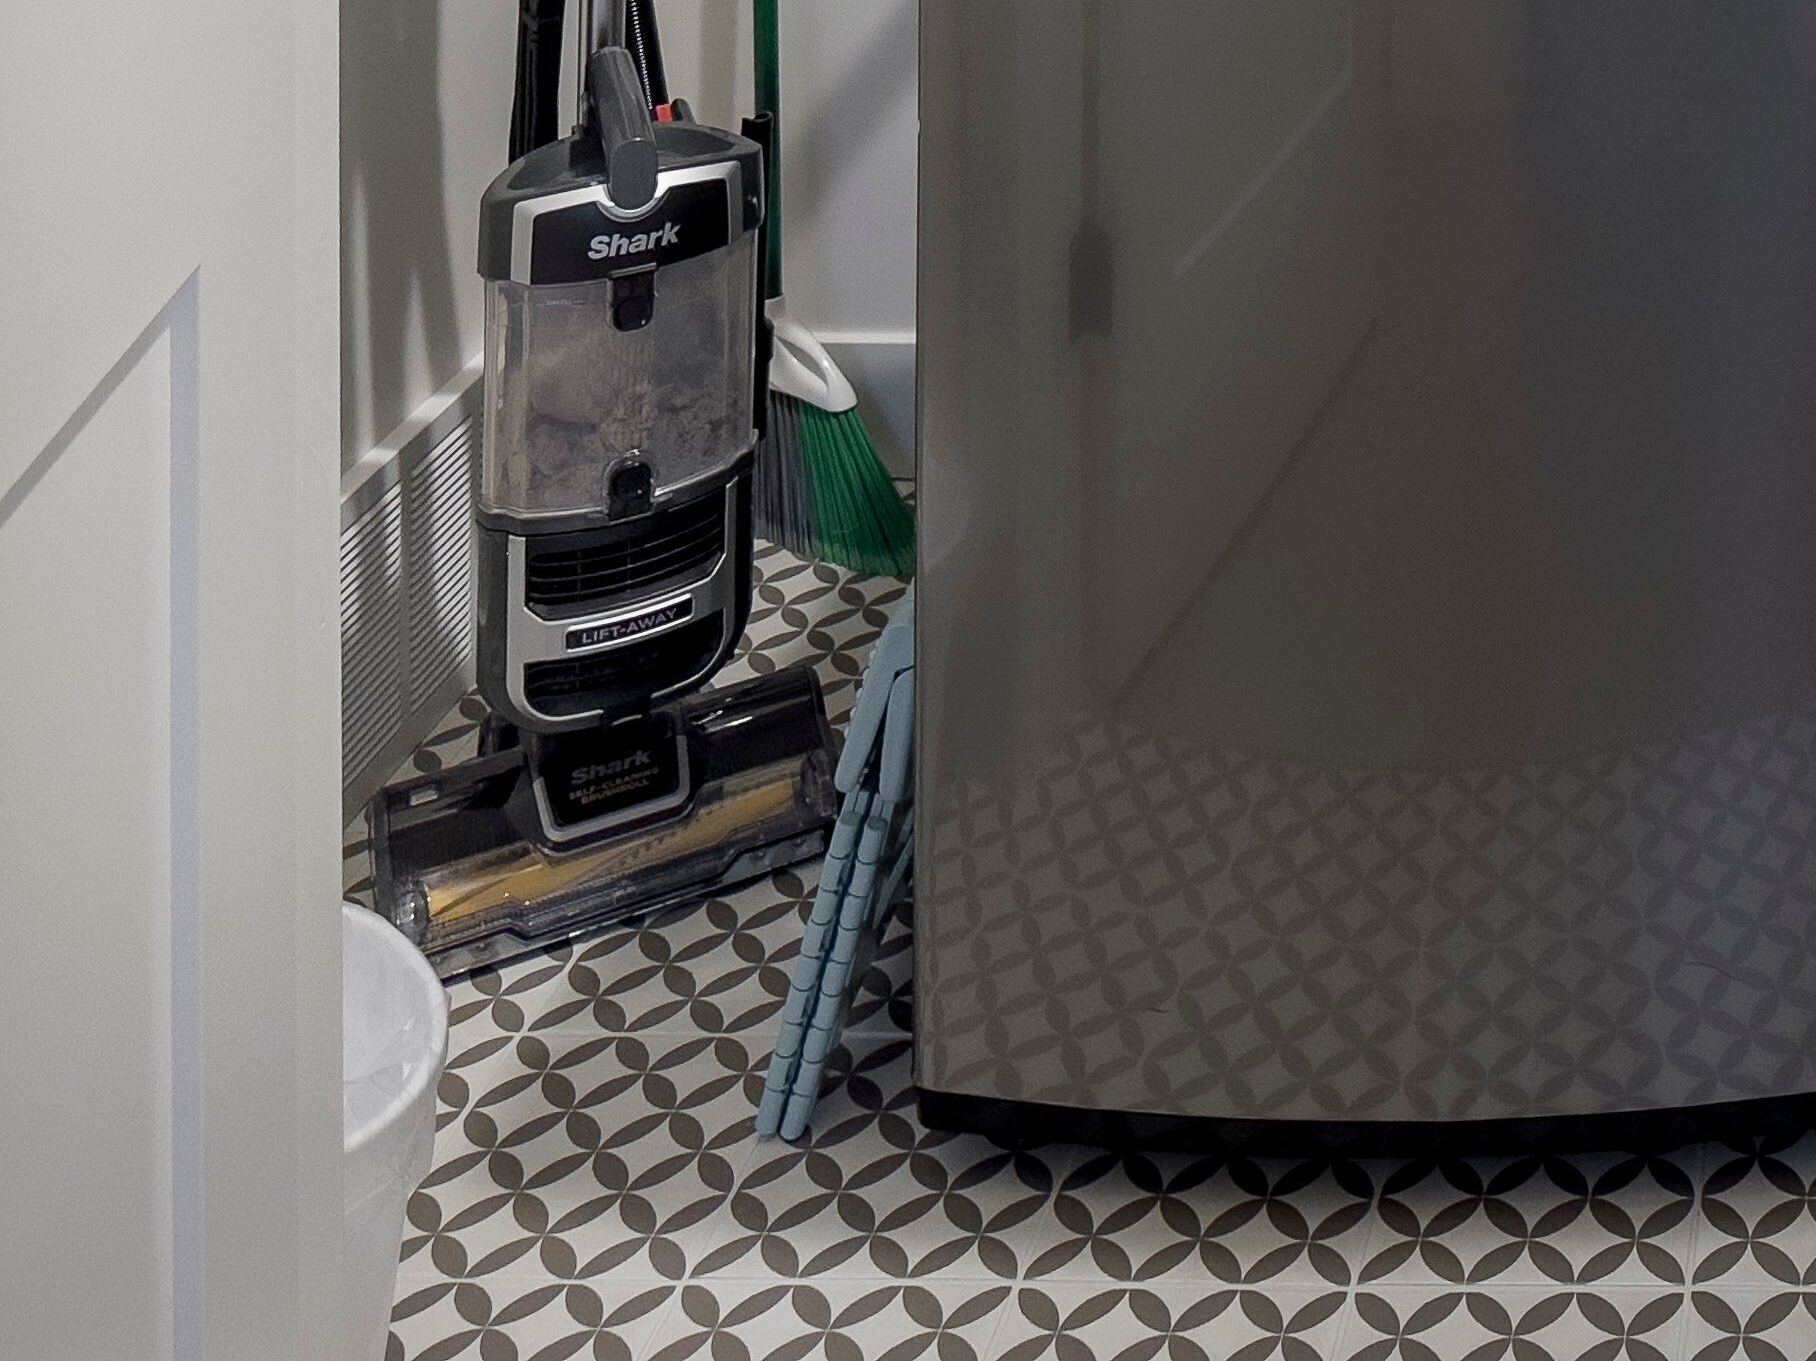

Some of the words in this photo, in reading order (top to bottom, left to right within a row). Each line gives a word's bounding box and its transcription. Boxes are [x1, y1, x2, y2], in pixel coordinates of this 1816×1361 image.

[588, 222, 680, 259] Shark
[582, 608, 676, 643] LIFT-AWAY
[571, 750, 651, 785] Shark
